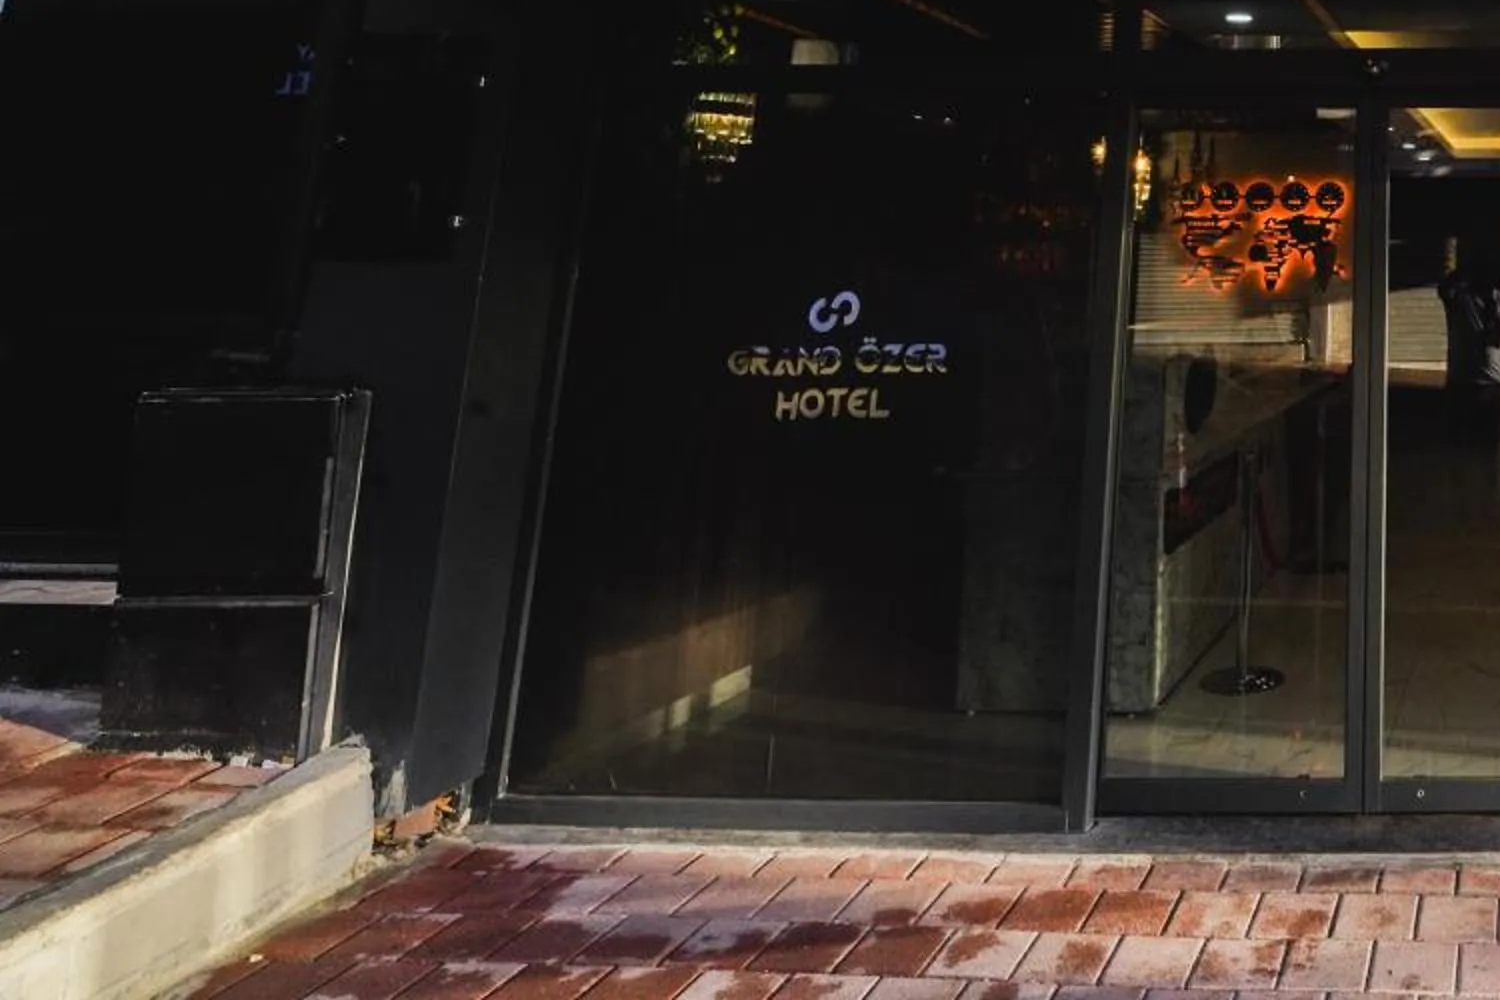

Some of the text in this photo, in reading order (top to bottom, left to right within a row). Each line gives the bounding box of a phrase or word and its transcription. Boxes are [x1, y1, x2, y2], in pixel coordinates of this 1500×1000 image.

[728, 337, 948, 376] GRAND ÖZER
[775, 388, 890, 421] HOTEL
